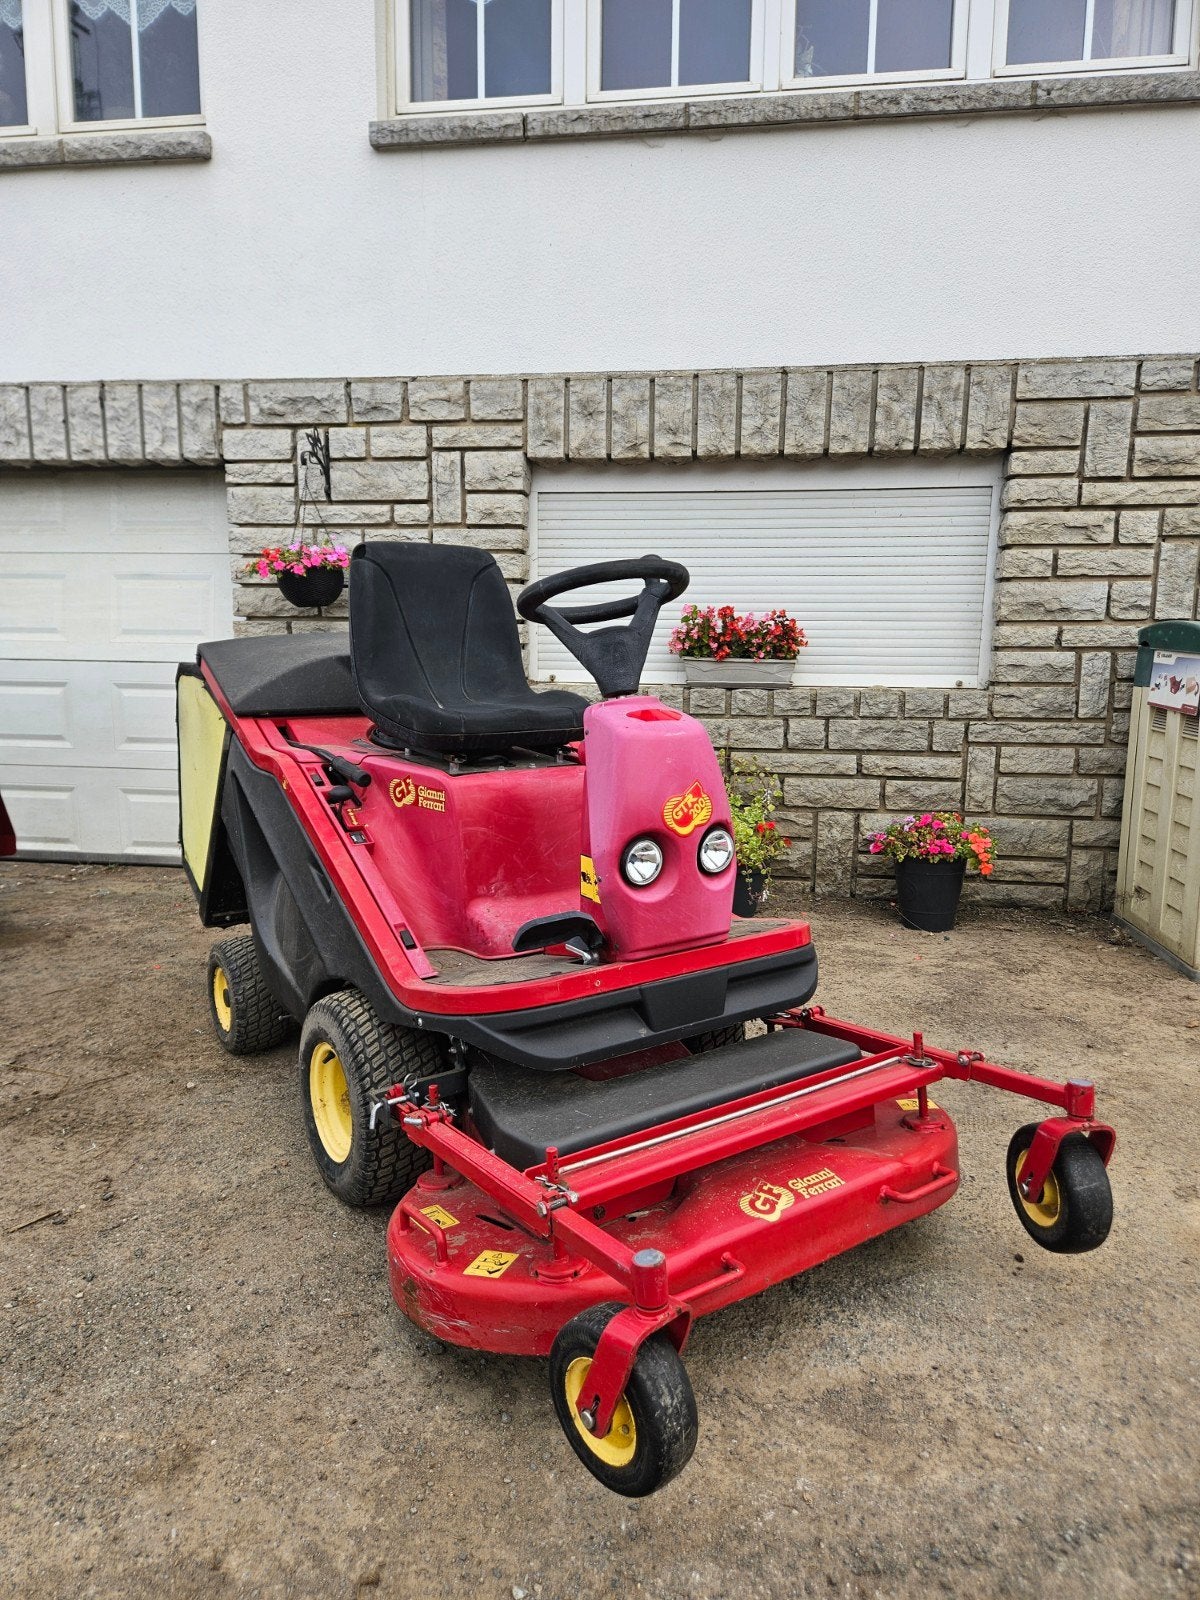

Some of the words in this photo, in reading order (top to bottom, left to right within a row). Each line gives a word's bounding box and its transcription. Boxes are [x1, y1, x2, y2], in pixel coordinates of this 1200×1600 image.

[418, 785, 446, 801] Gianni
[418, 796, 446, 812] Ferrari
[672, 793, 699, 820] GTR
[689, 797, 706, 820] 200
[788, 1167, 836, 1191] Gianni
[798, 1176, 846, 1199] Ferrari
